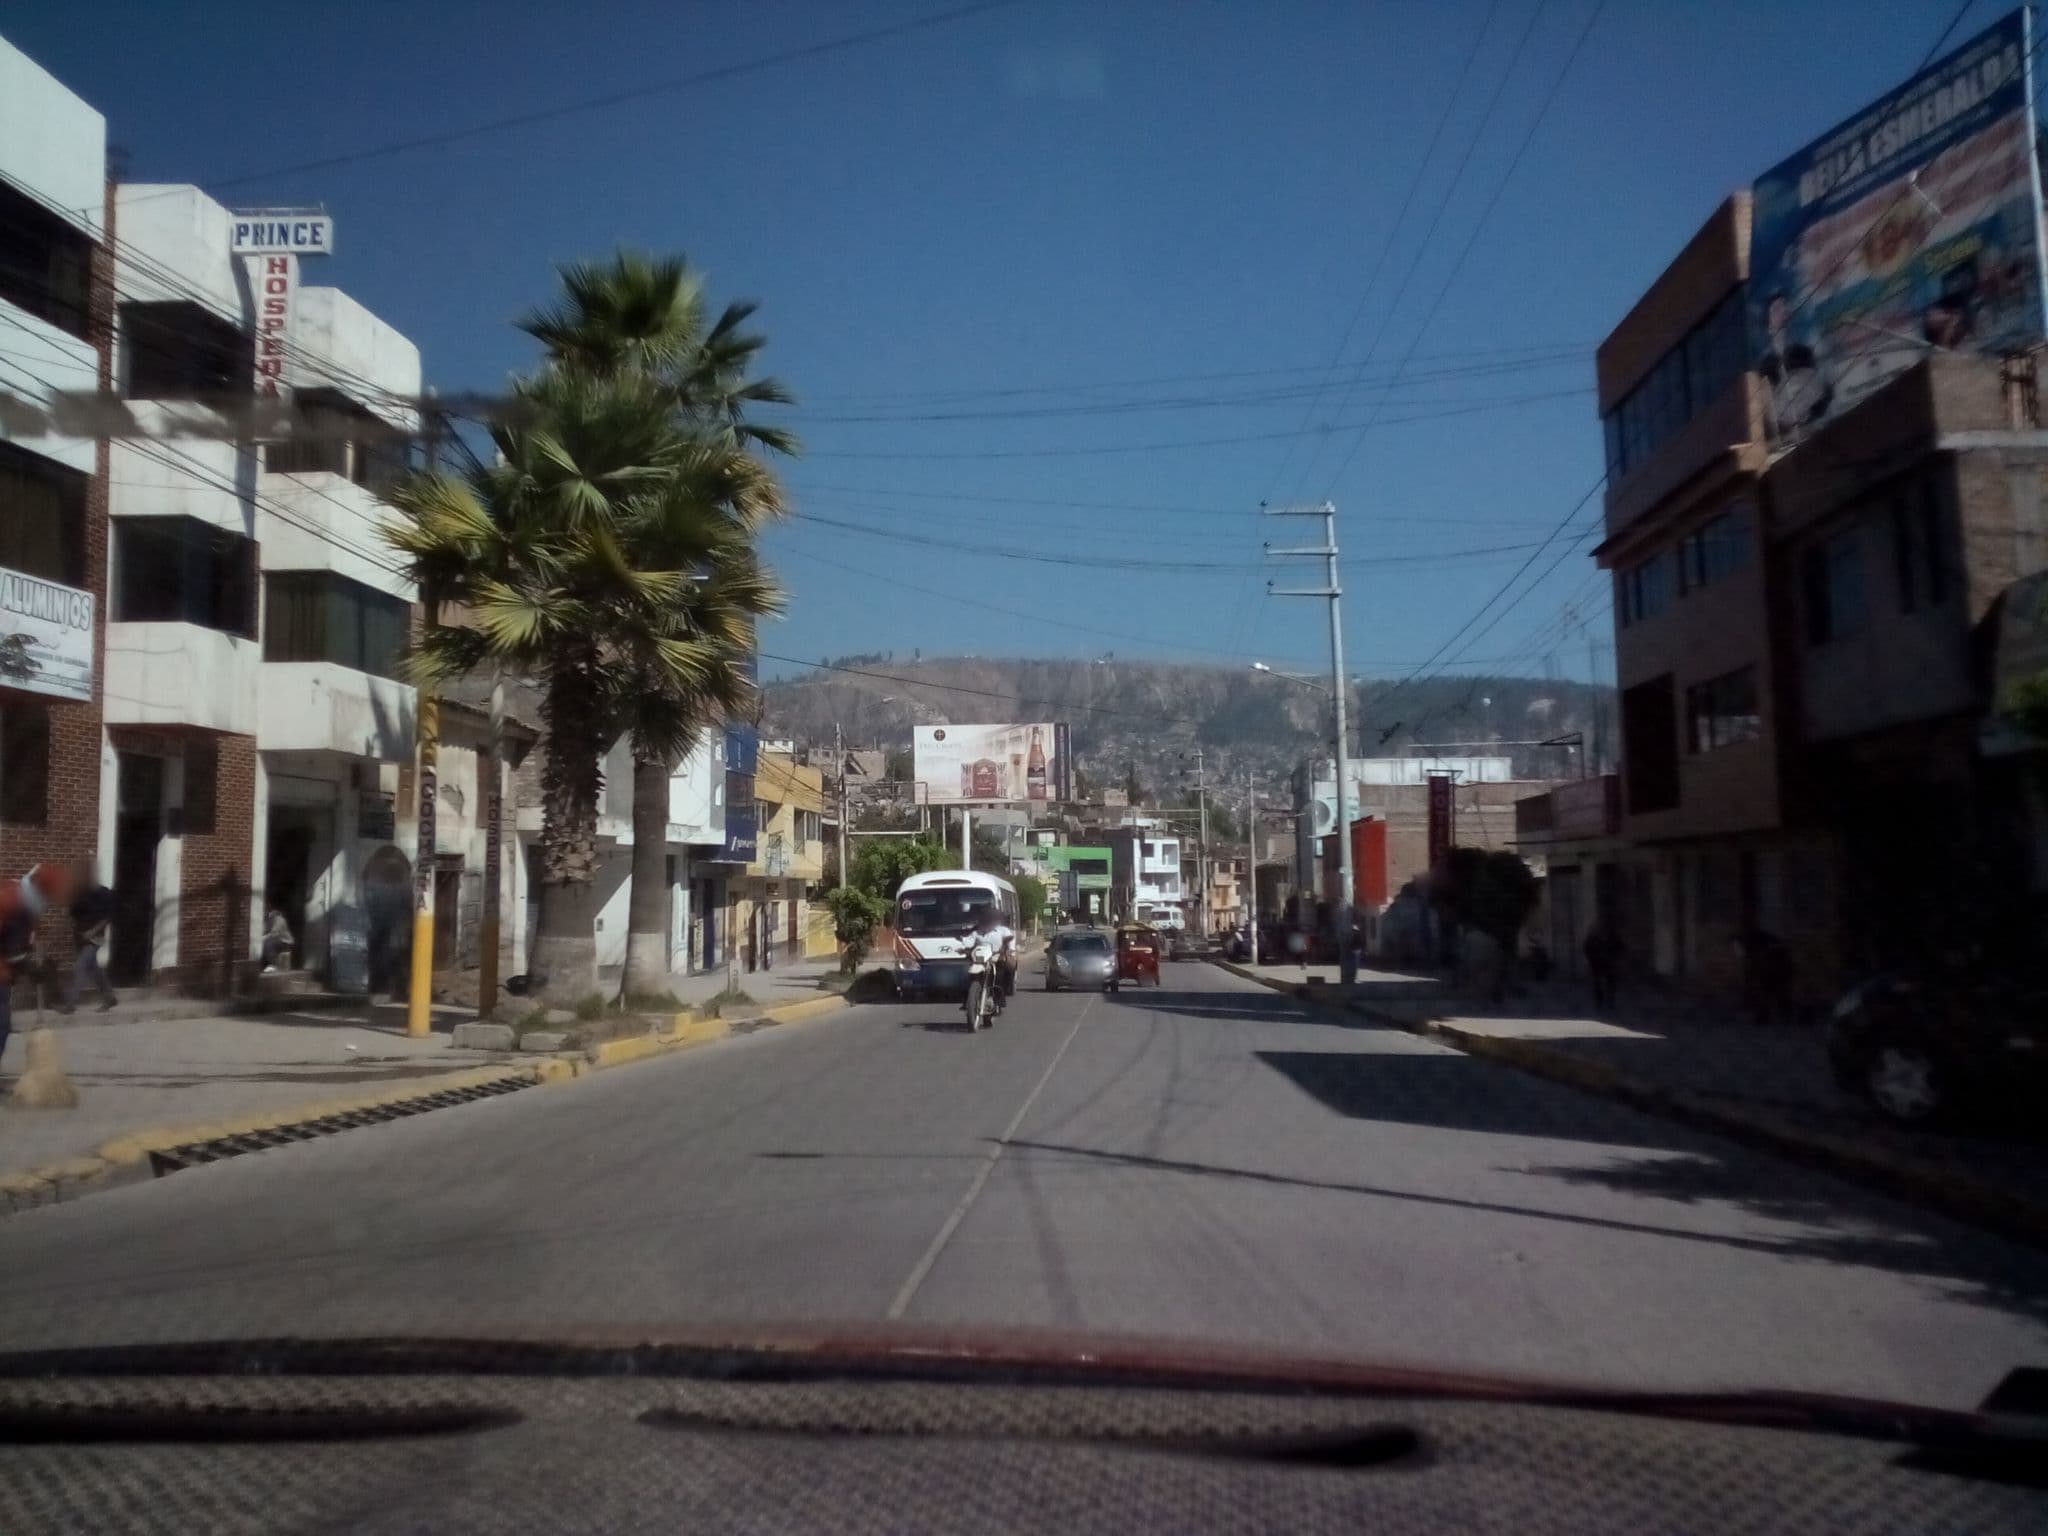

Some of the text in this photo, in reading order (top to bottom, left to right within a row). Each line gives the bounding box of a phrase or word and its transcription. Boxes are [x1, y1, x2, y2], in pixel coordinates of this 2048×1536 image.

[234, 222, 325, 247] PRINCE
[261, 256, 289, 400] HOSPEDA
[0, 572, 92, 632] ALUMINIOS
[1433, 777, 1448, 858] BOTIC
